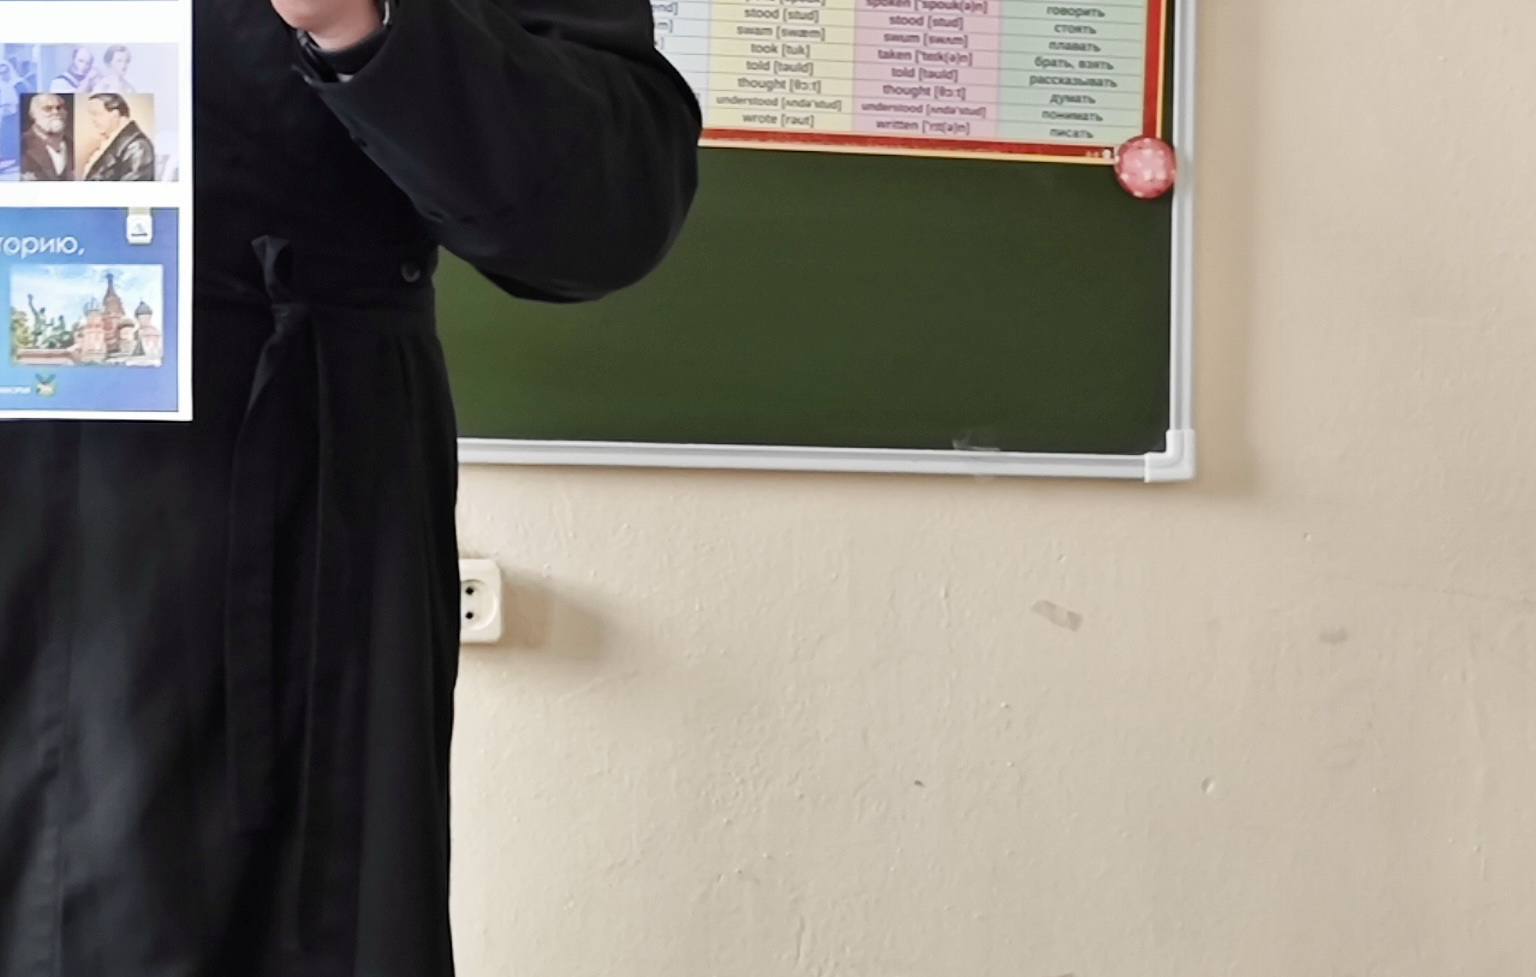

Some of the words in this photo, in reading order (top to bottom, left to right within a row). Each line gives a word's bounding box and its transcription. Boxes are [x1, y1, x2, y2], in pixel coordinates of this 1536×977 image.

[744, 6, 780, 19] stood
[888, 13, 925, 26] stood
[736, 25, 773, 36] swam
[750, 41, 779, 54] took
[877, 47, 913, 60] taken
[745, 58, 771, 71] told
[891, 65, 916, 78] told
[737, 76, 787, 92] thought
[882, 82, 931, 98] thought
[742, 111, 778, 124] wrote
